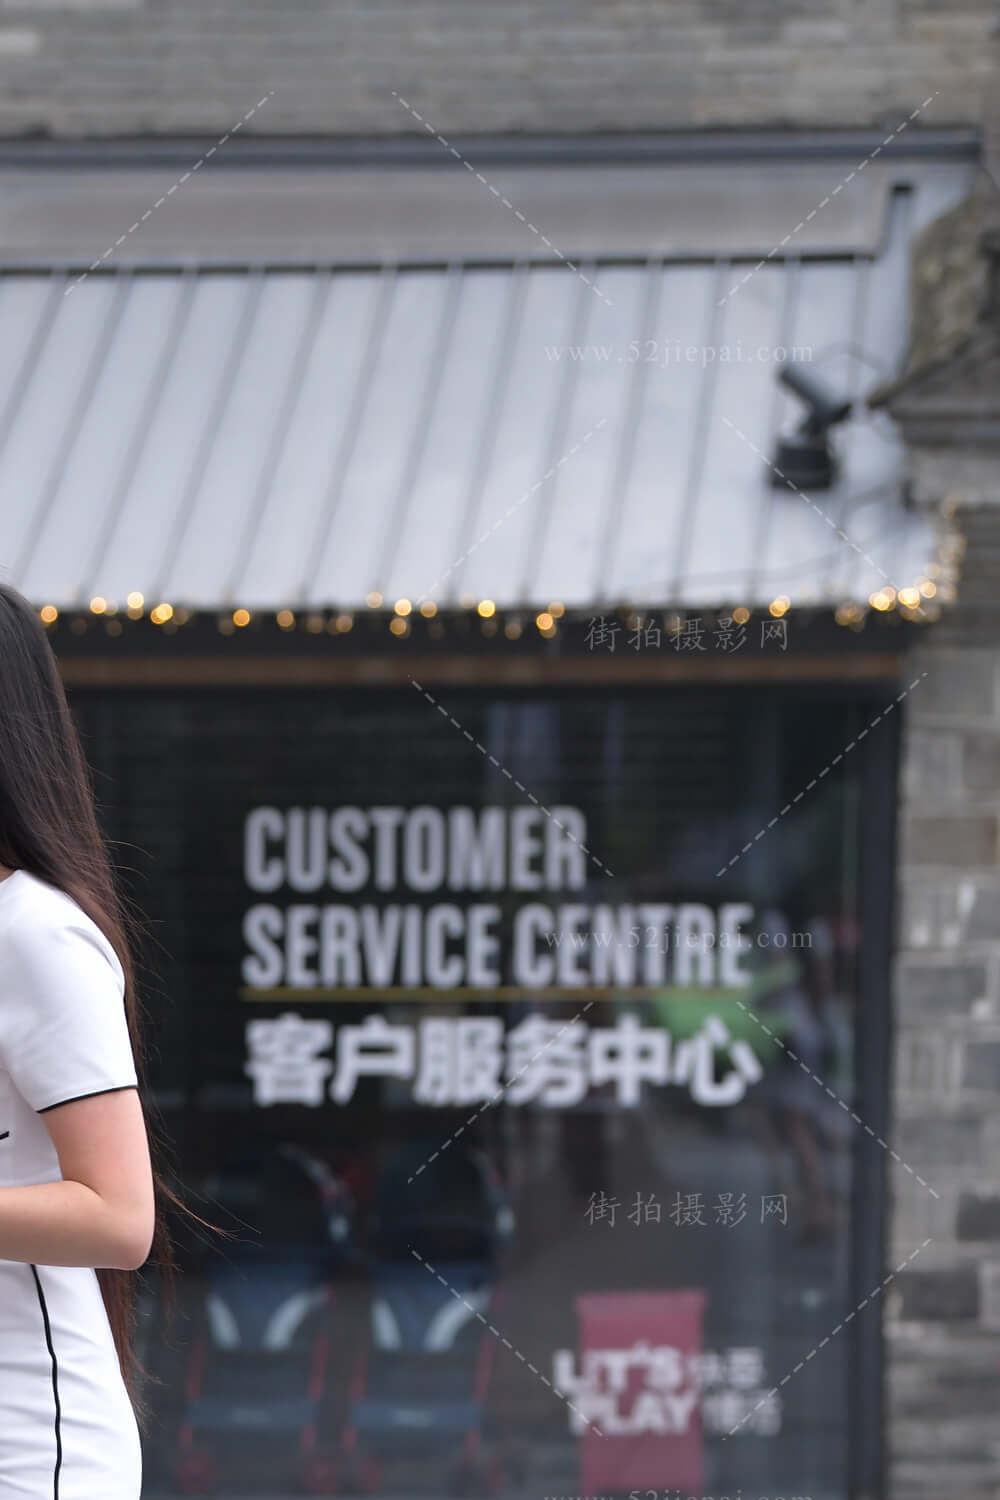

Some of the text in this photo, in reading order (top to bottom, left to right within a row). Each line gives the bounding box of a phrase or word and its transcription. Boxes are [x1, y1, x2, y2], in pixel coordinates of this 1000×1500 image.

[244, 806, 587, 891] CUSTOMER
[243, 904, 752, 989] SERVICE CENTRE
[246, 1015, 762, 1106] 客户服务中心
[570, 1390, 697, 1436] PLAY
